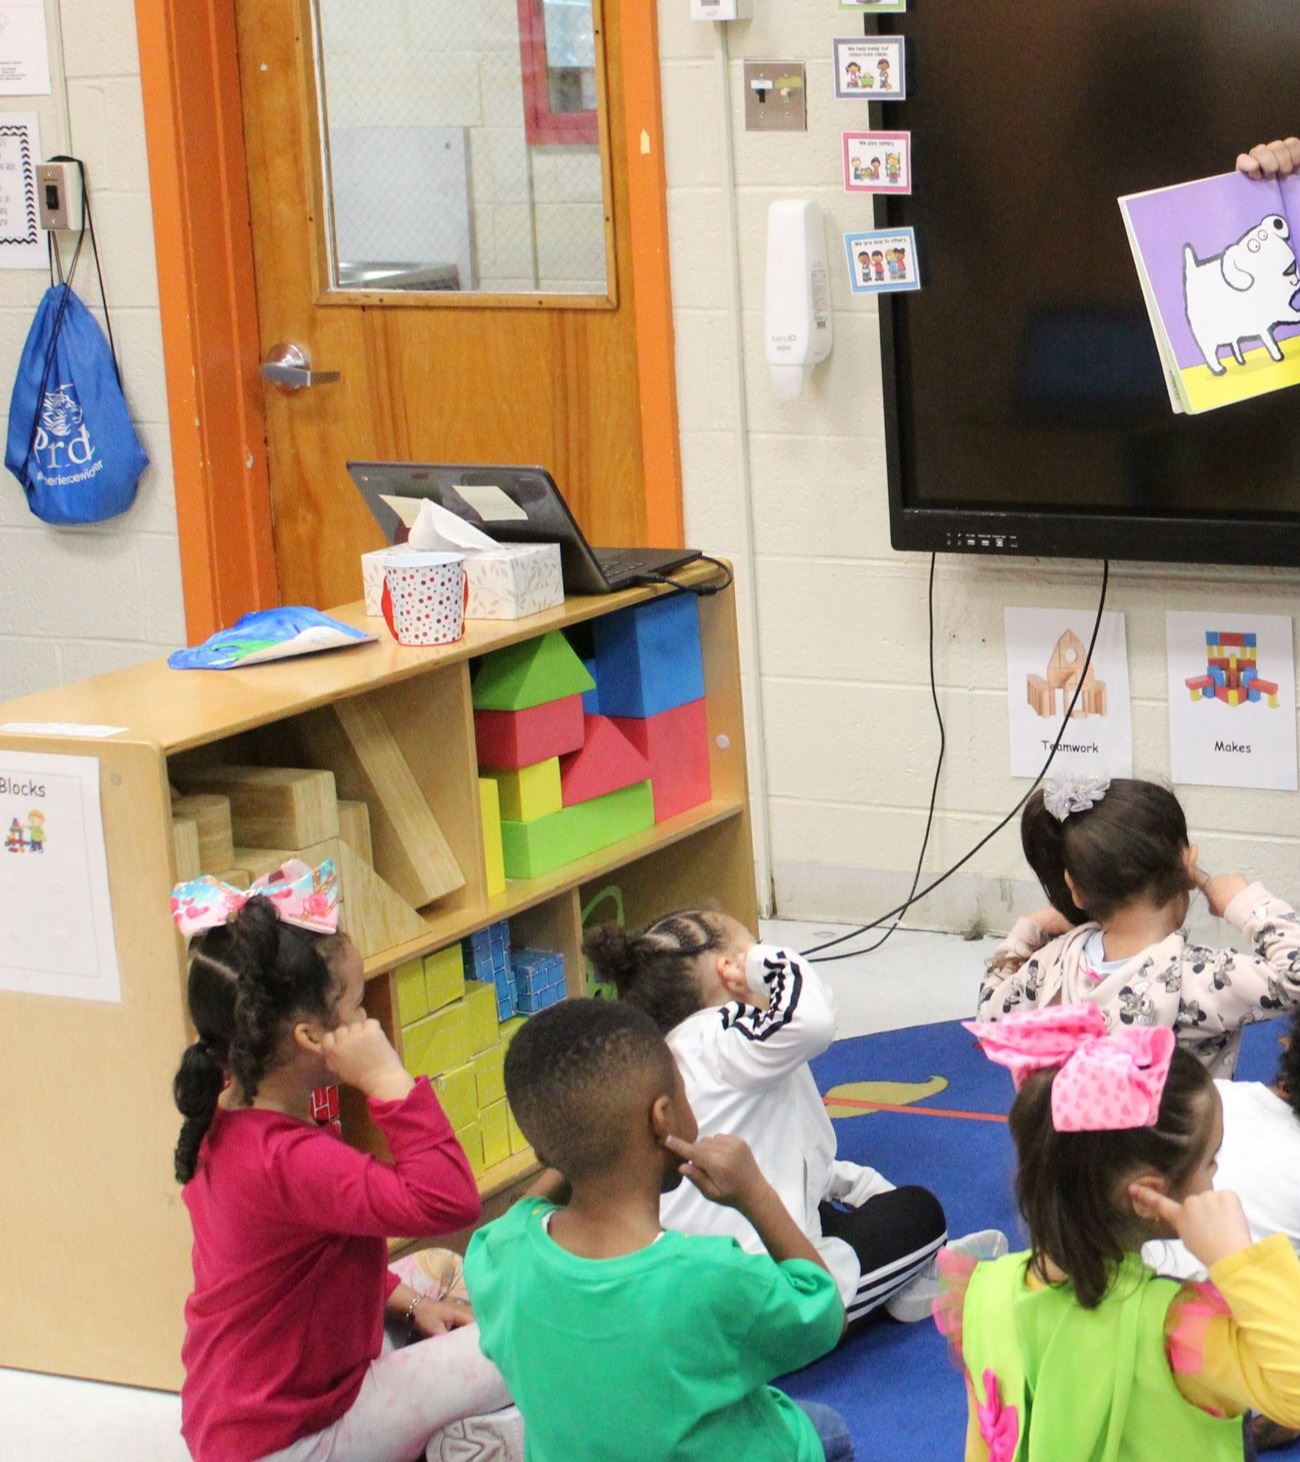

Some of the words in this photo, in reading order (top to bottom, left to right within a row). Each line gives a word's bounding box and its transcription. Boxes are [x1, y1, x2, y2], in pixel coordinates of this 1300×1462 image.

[1041, 740, 1099, 754] Teamwork
[1214, 740, 1251, 754] Makes
[0, 776, 46, 798] Blocks
